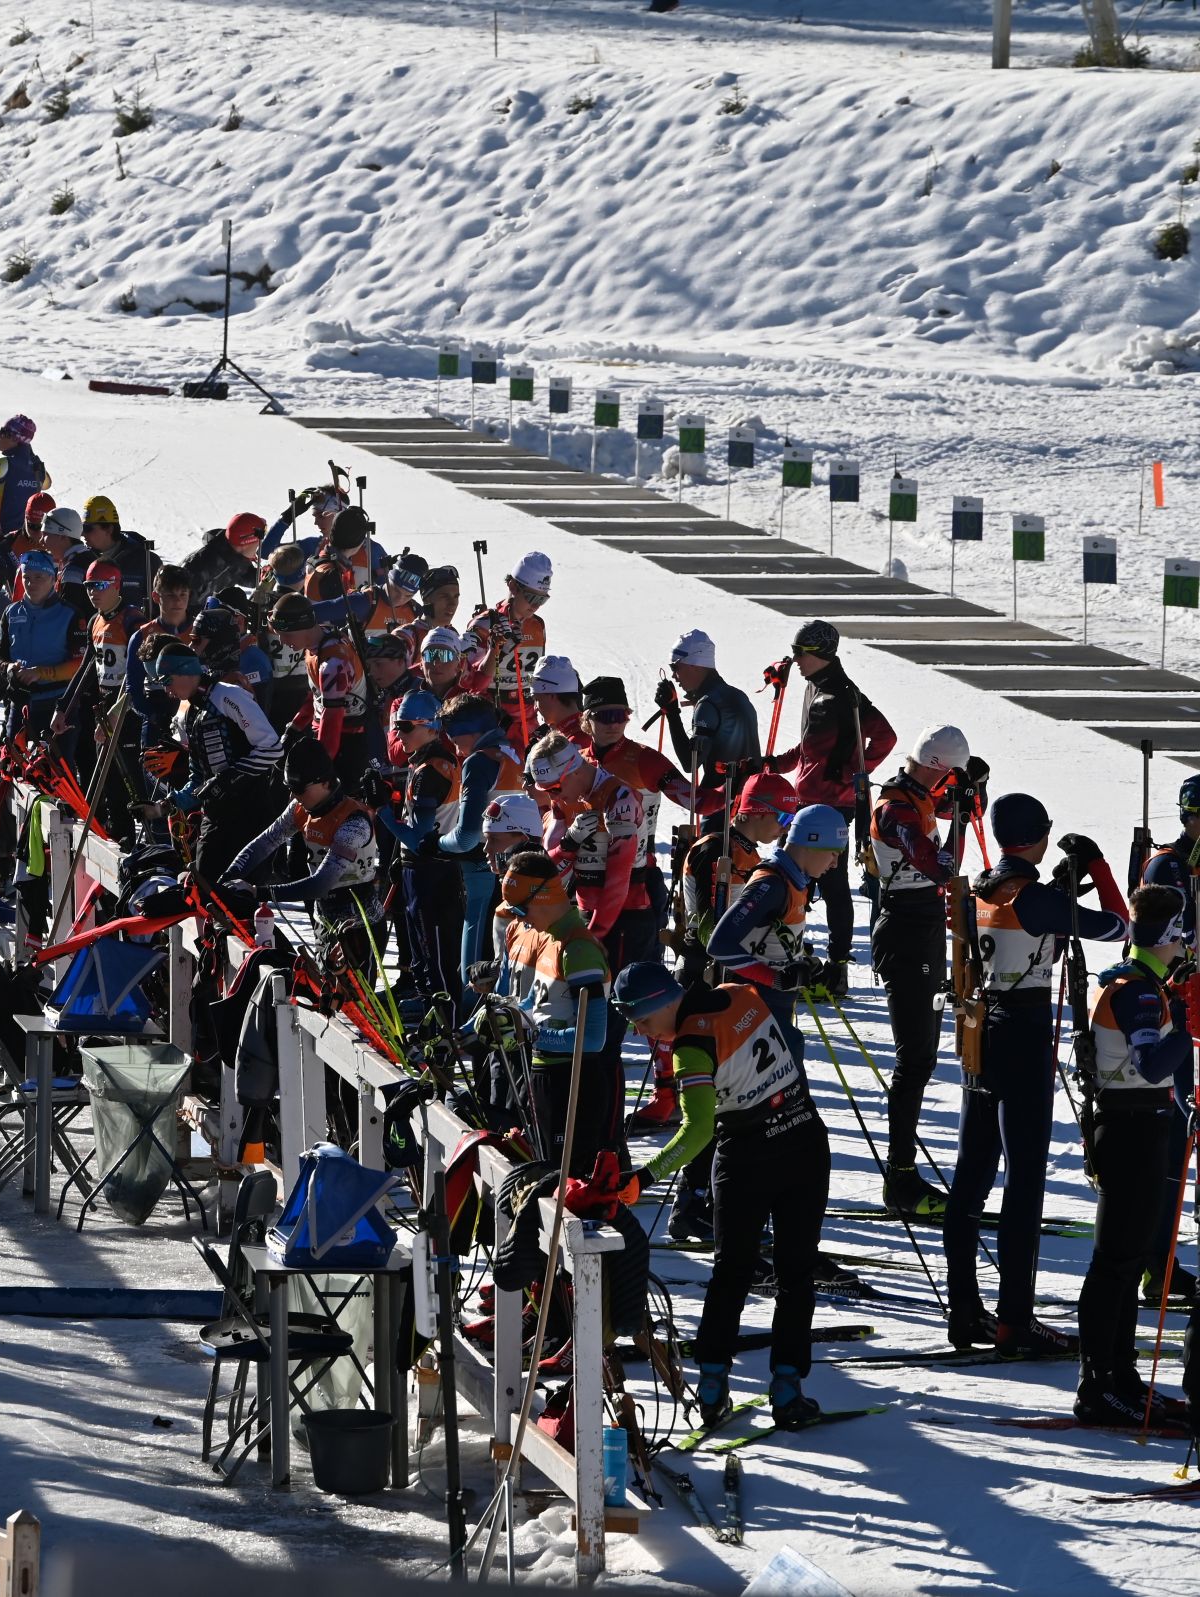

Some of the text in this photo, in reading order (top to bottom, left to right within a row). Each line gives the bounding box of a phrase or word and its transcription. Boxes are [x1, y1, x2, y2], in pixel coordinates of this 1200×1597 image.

[1019, 533, 1038, 558] 18
[1094, 556, 1112, 580] 17
[1174, 578, 1192, 605] 16
[506, 652, 539, 672] 62
[731, 1009, 759, 1034] ARGETA
[752, 1023, 787, 1074] 21
[817, 1287, 861, 1297] SALOMON
[1030, 1319, 1068, 1348] lpina
[1102, 1391, 1145, 1421] alpina
